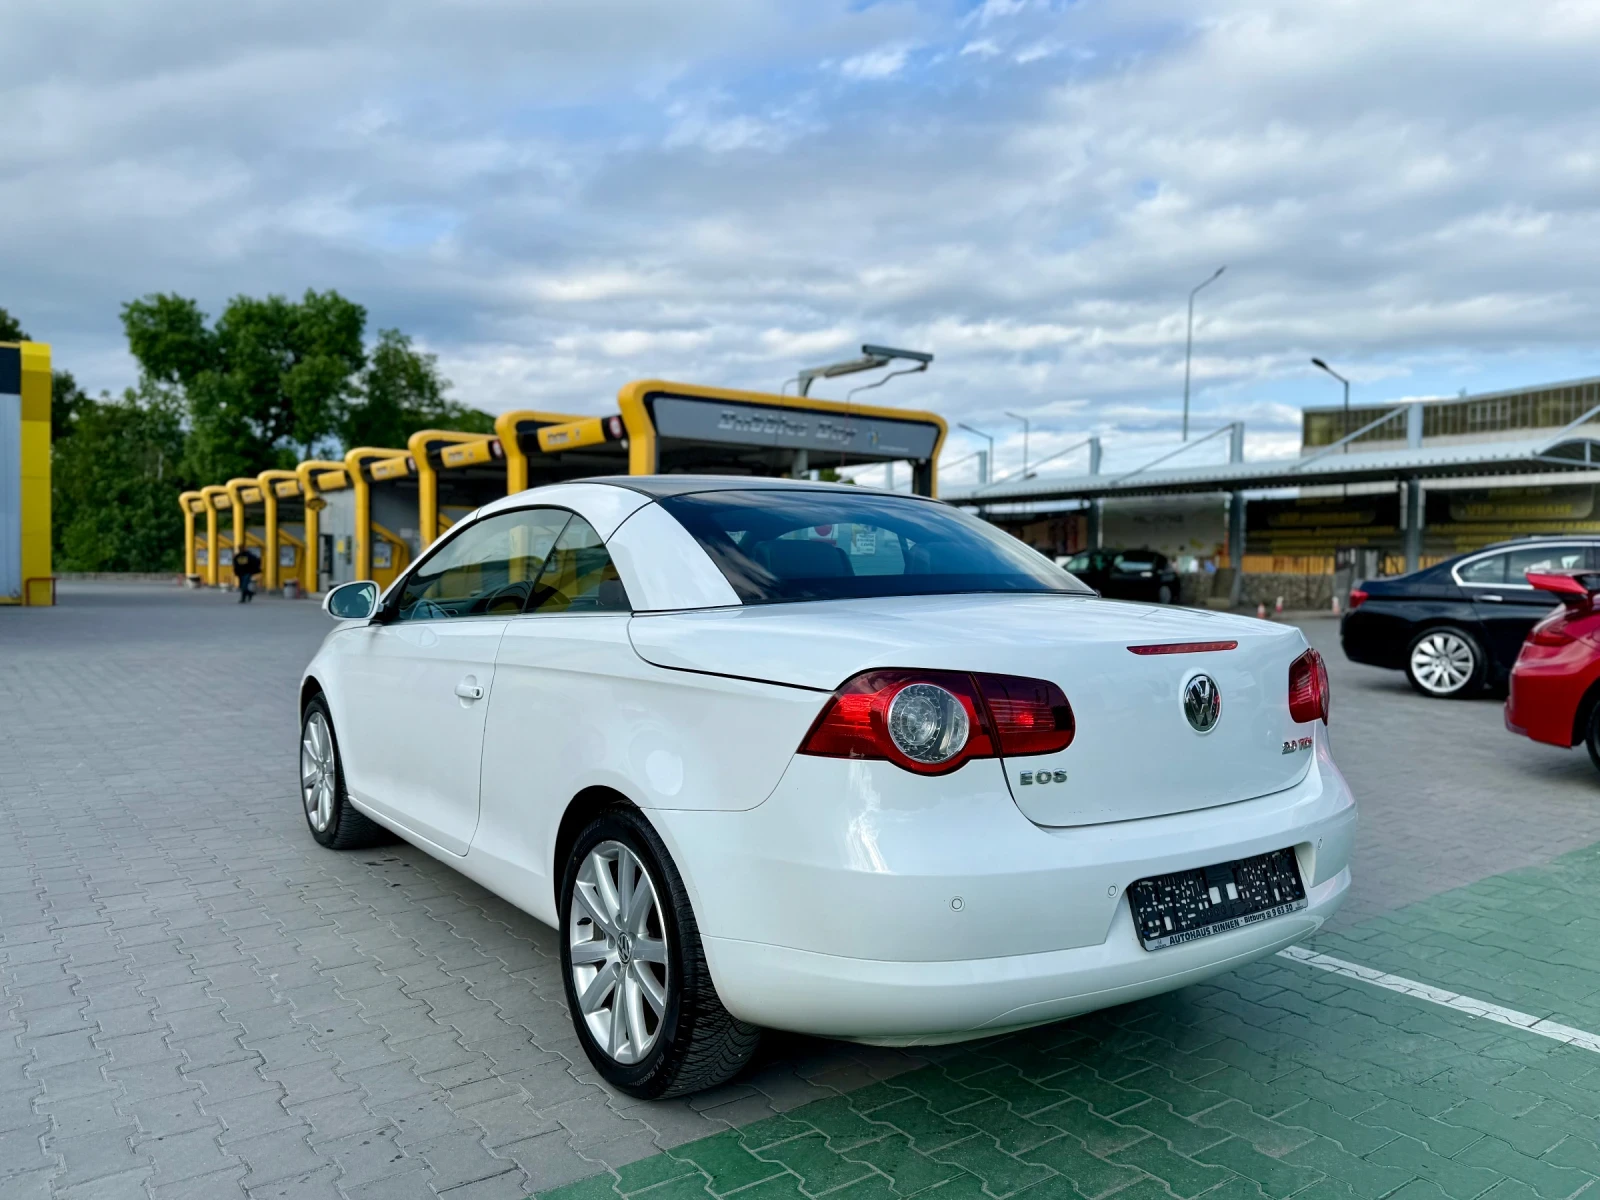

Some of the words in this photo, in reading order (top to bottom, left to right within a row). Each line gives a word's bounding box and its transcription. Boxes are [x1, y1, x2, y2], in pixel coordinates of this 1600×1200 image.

[1019, 768, 1068, 786] EOS
[1169, 927, 1211, 945] AUTOHAUS
[1212, 919, 1240, 934] RINNEN
[1243, 913, 1266, 923] Bitburg
[1285, 903, 1293, 912] 30
